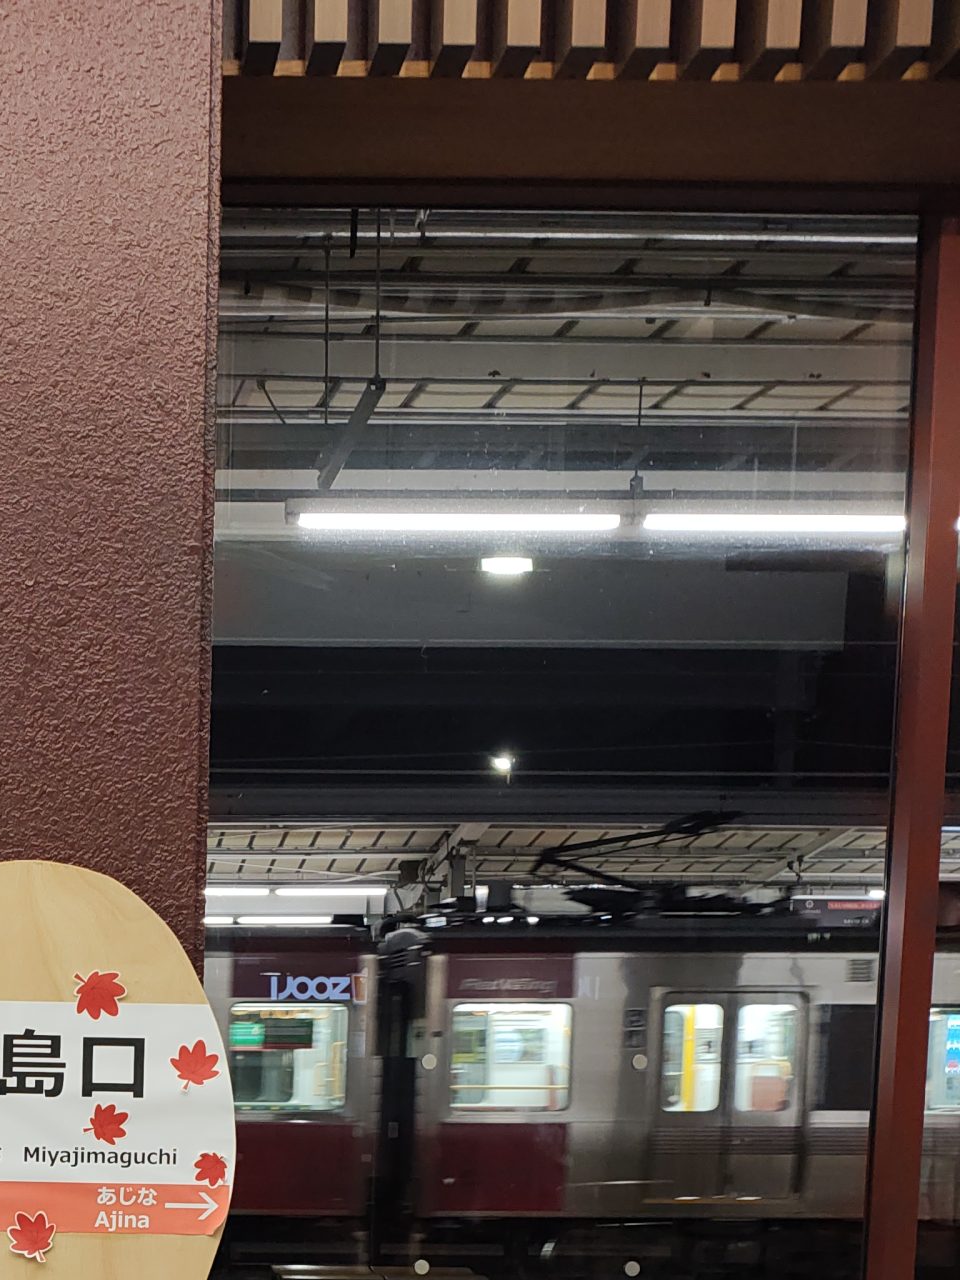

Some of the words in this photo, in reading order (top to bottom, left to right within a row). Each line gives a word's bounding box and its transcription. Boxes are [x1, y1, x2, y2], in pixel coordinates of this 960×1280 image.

[23, 1146, 178, 1168] Miyajimaguchi
[96, 1186, 158, 1206] あじな
[94, 1211, 150, 1232] Ajina
